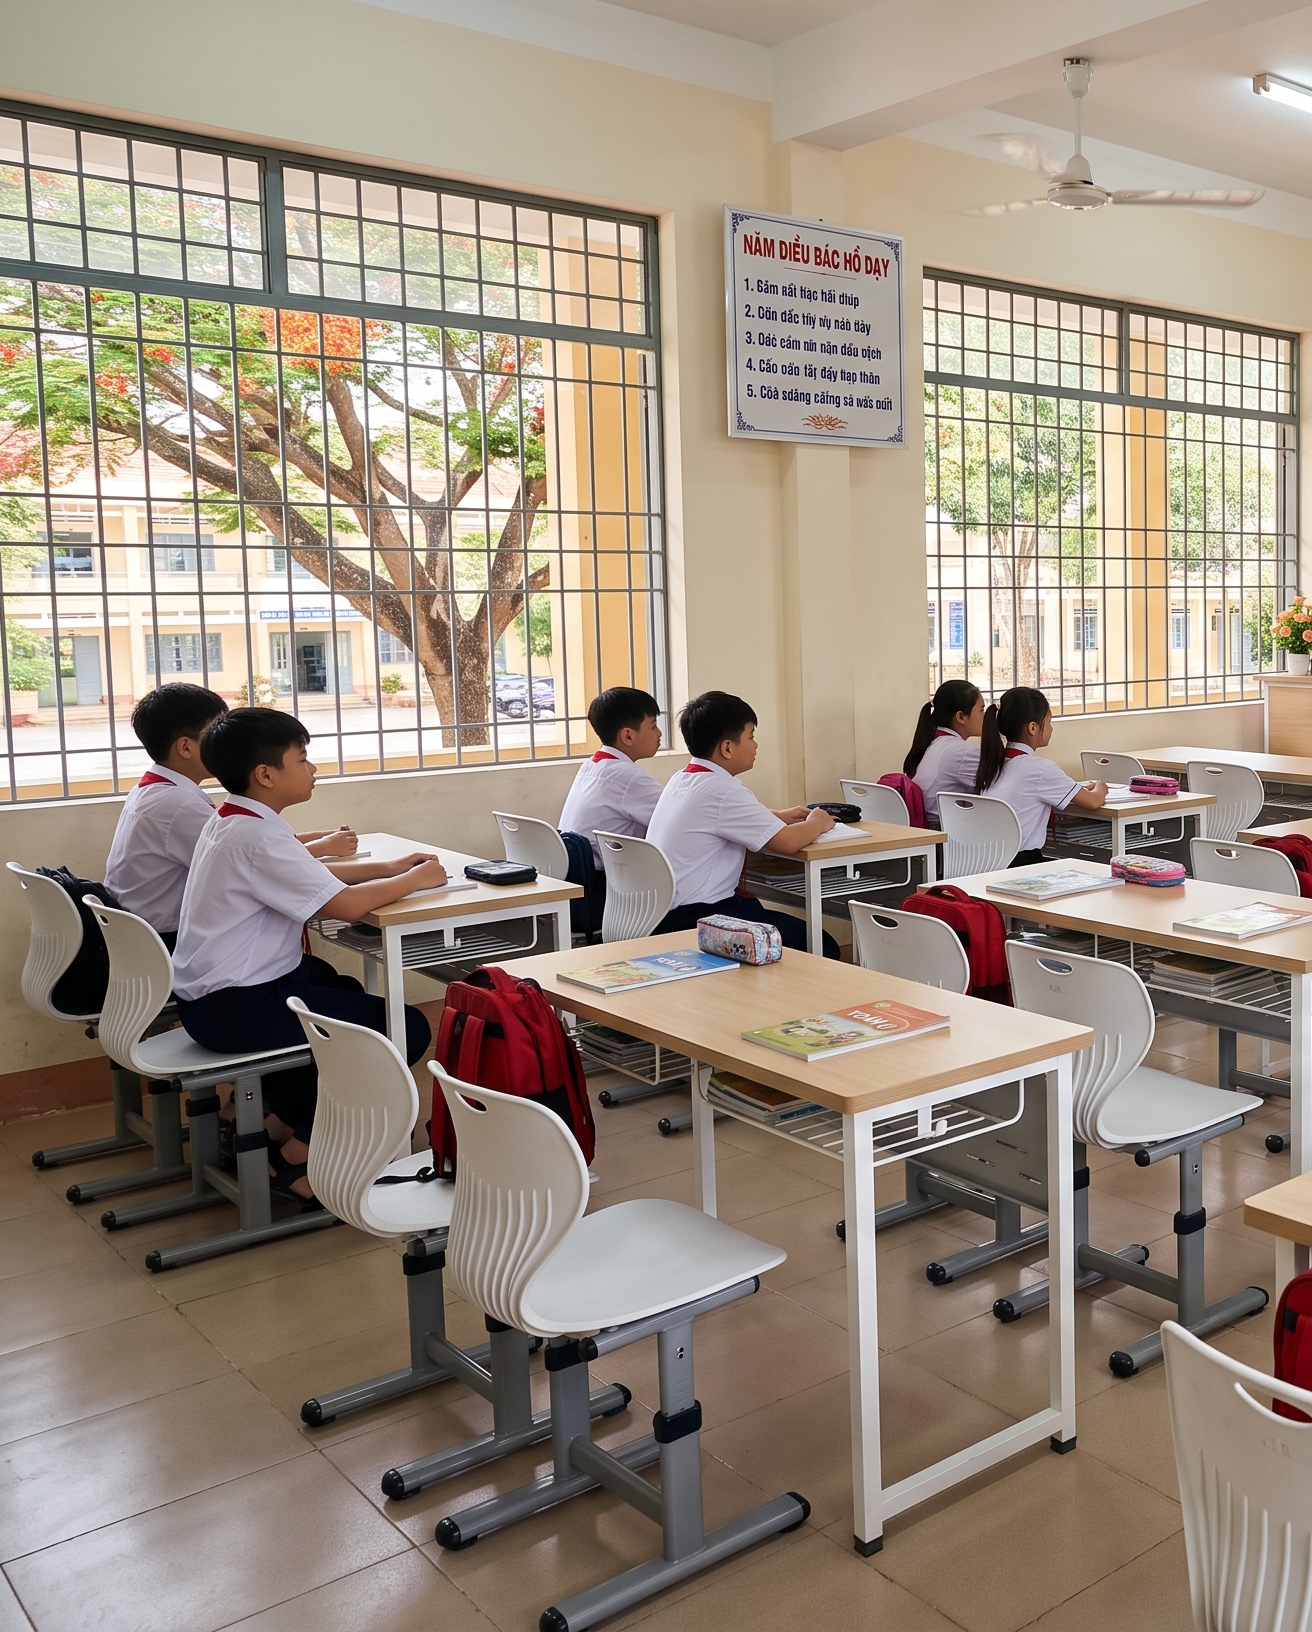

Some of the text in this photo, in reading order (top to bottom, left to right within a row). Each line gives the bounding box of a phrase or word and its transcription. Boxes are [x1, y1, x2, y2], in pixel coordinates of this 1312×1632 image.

[744, 230, 775, 258] NĂM
[814, 244, 840, 269] BÁC
[844, 245, 861, 273] HỒ
[865, 255, 890, 281] DẠY
